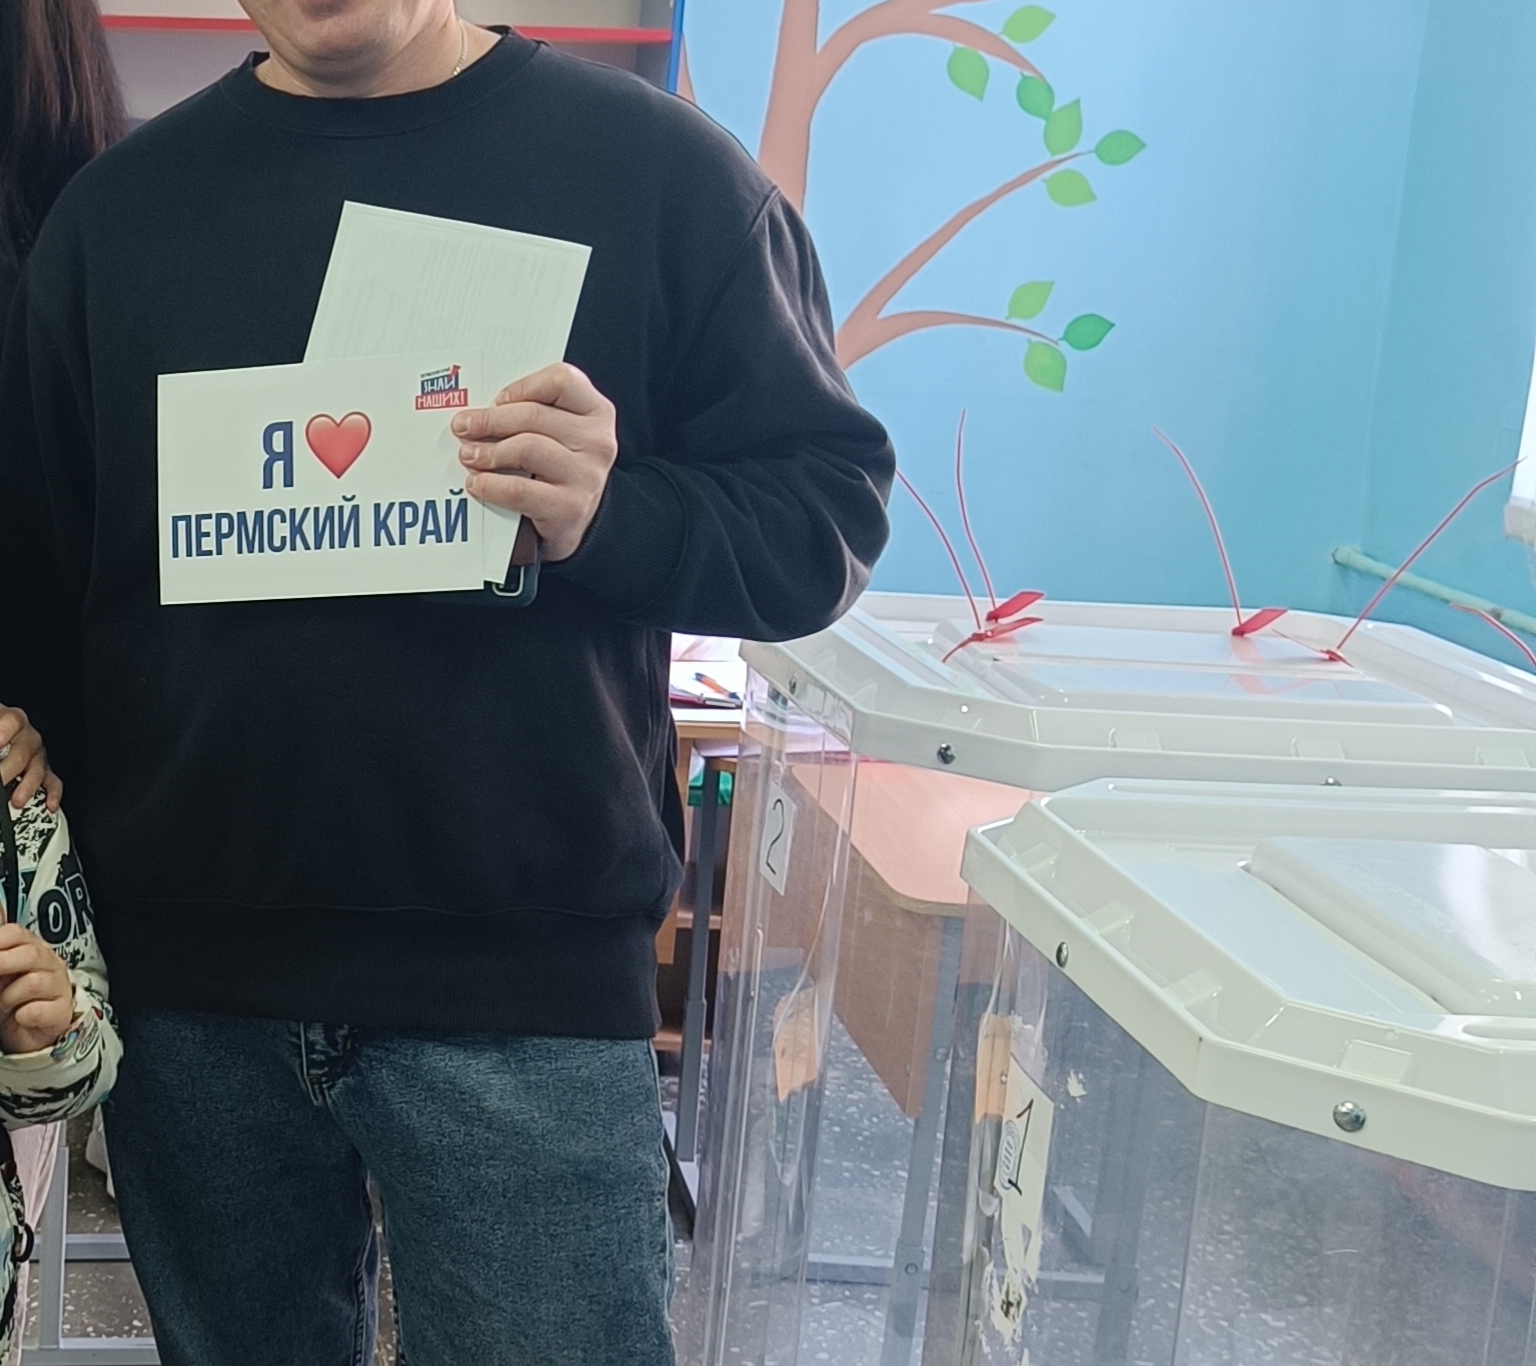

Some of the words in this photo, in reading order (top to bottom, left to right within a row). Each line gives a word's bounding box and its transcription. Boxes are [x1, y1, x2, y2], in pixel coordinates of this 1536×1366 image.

[417, 391, 464, 408] НАШИХ!
[262, 420, 294, 490] Я
[171, 494, 361, 558] ПЕРМСКИЙ
[373, 488, 469, 547] КРАЙ
[765, 798, 785, 875] 2
